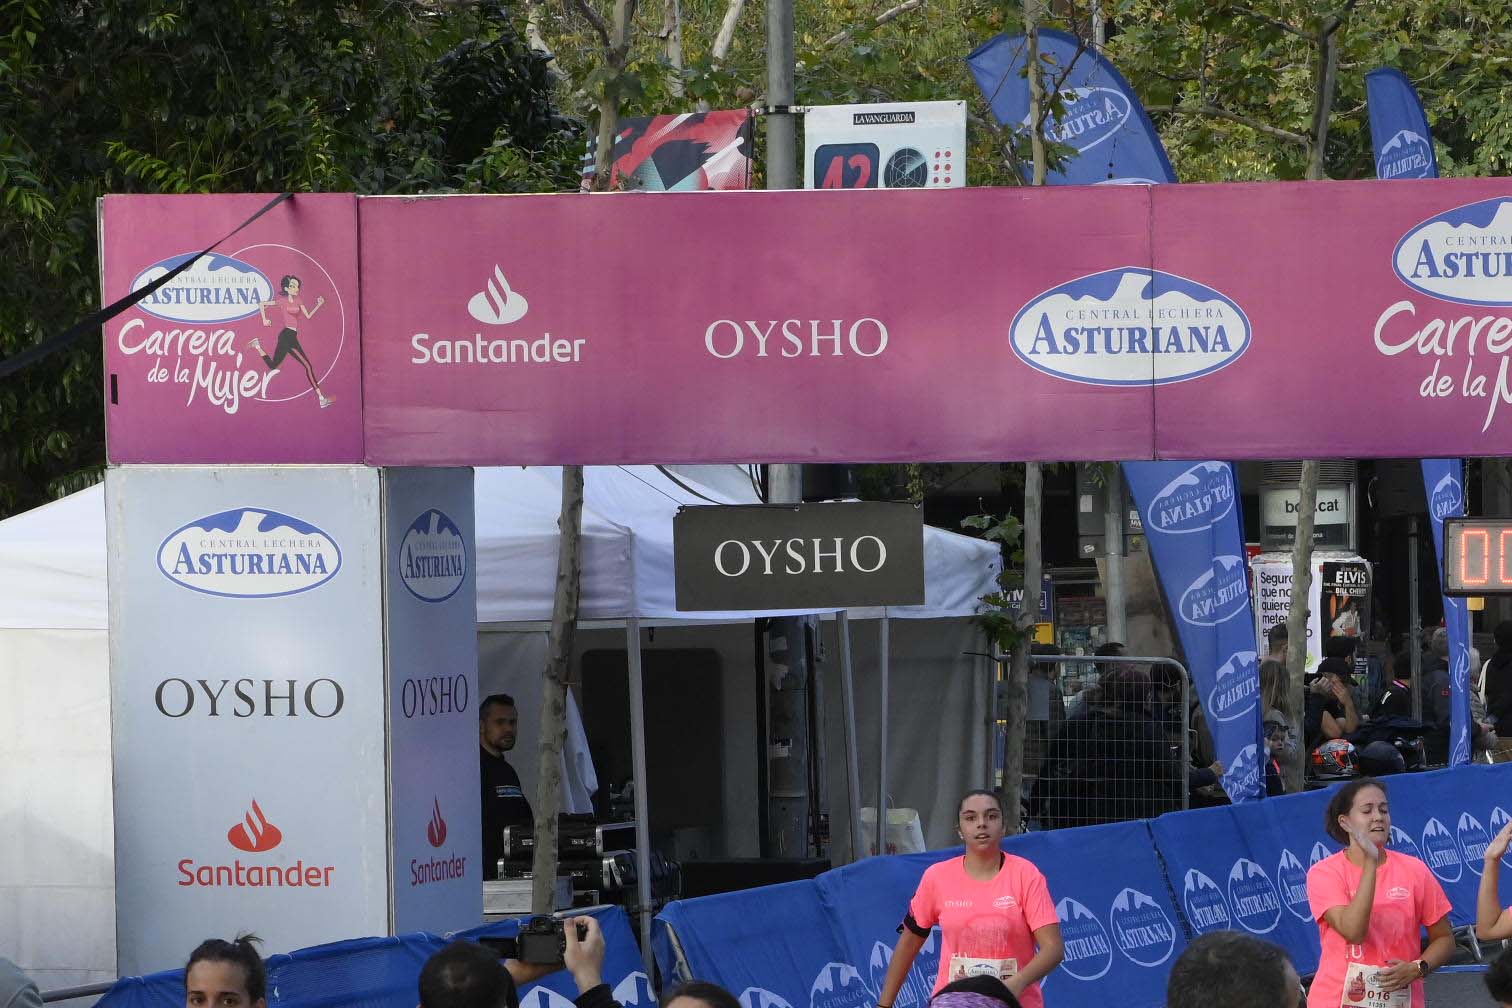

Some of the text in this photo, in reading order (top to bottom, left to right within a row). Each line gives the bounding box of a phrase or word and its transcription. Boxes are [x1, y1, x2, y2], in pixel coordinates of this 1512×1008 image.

[1065, 307, 1224, 321] CENTRAL LECHERA
[118, 318, 236, 356] Carrera
[411, 332, 586, 365] Santander
[704, 318, 889, 360] OYSHO
[1028, 313, 1232, 356] ASTURIANA
[147, 352, 281, 415] de la Mujer
[1419, 360, 1454, 398] de
[1462, 358, 1487, 397] la
[171, 541, 329, 576] ASTURIANA
[200, 538, 322, 549] CENTRAL LECHERA
[714, 535, 888, 577] OYSHO
[404, 547, 463, 580] ASTURIANA
[1335, 571, 1367, 584] ELVIS
[154, 677, 346, 719] OYSHO
[401, 673, 469, 720] OYSHO
[177, 858, 335, 888] Santander
[410, 853, 466, 889] Santander
[1367, 990, 1391, 1001] 016
